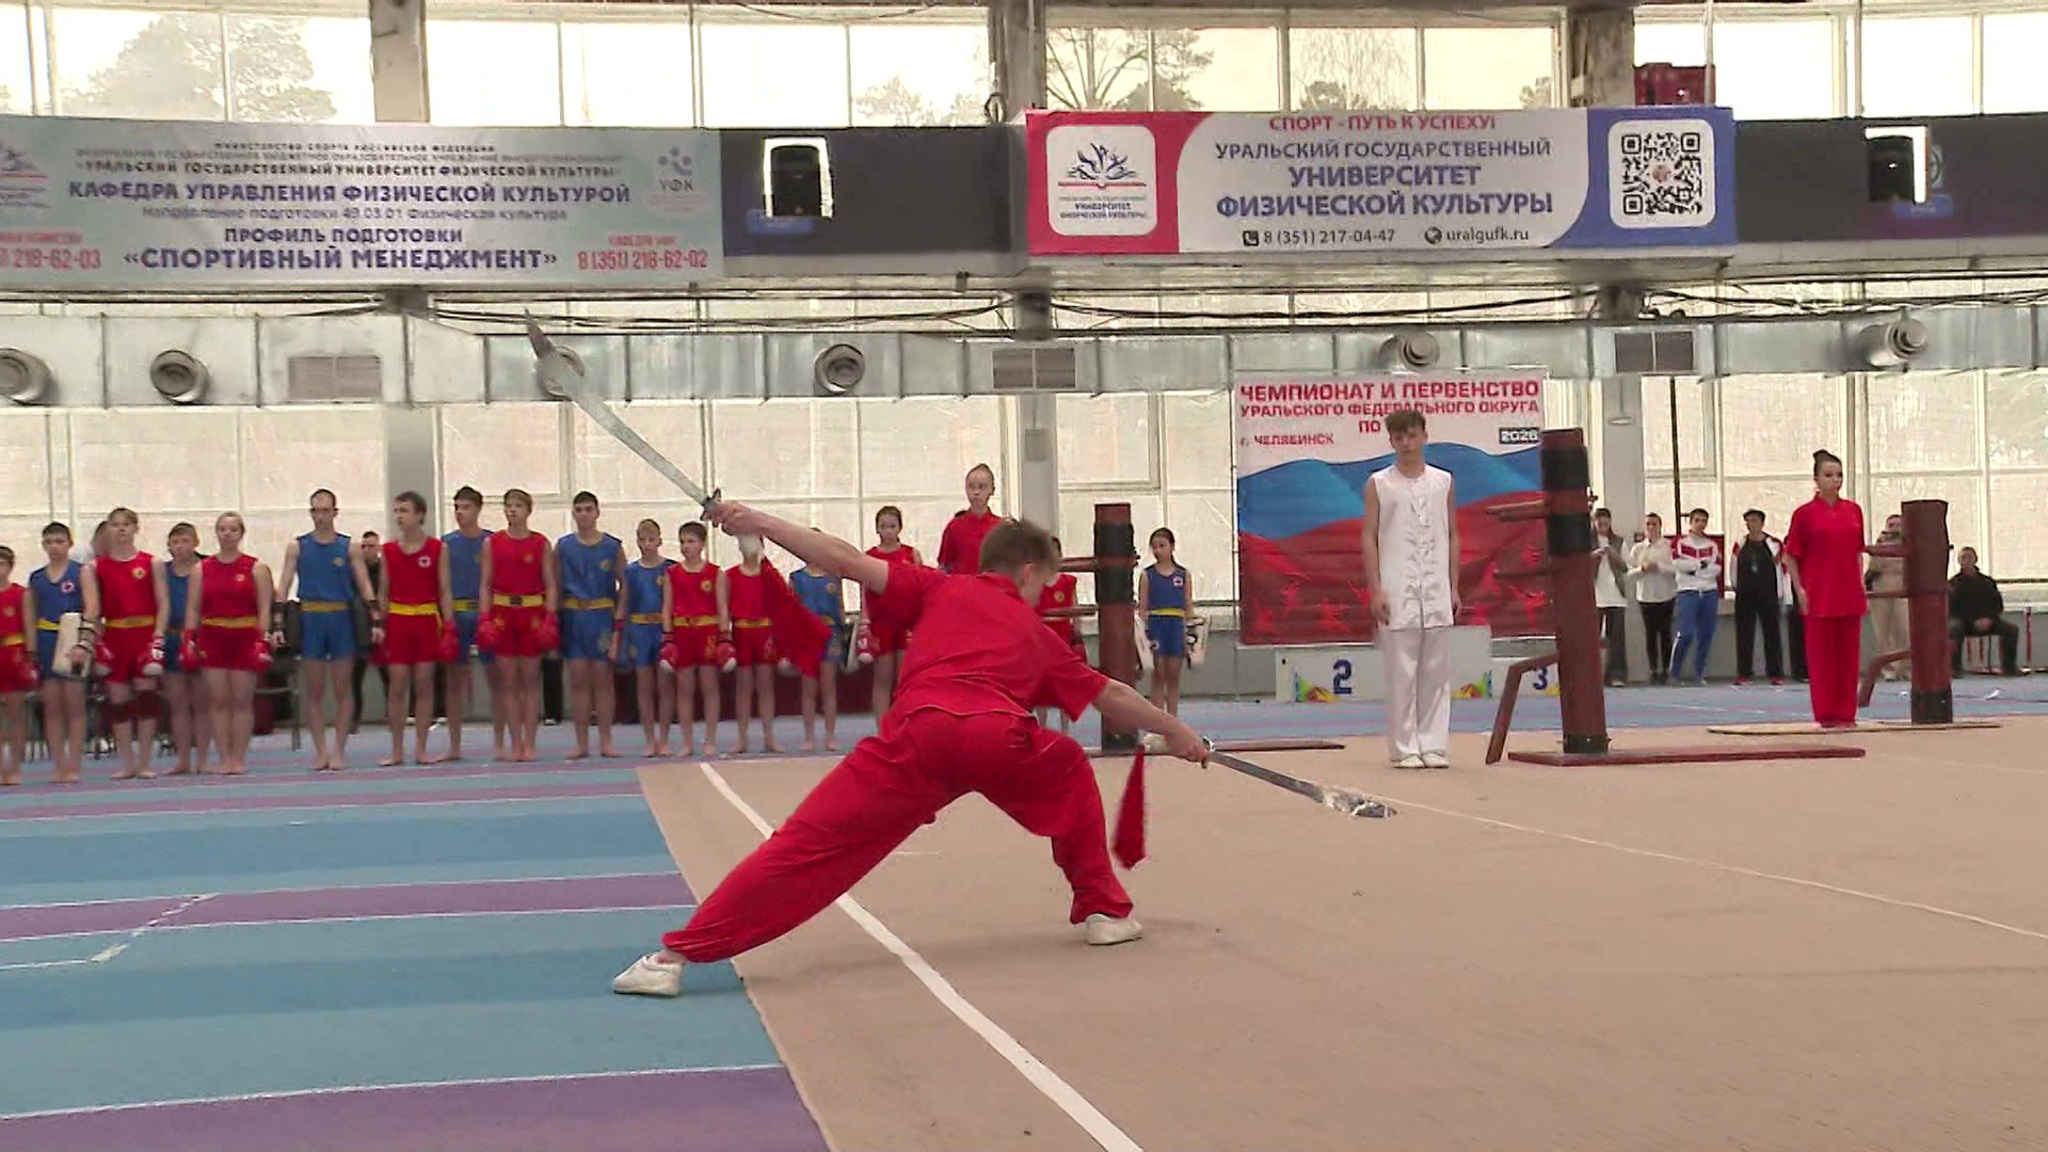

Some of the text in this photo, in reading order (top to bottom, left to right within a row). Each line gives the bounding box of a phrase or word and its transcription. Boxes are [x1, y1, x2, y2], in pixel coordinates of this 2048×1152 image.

[1269, 115, 1332, 131] СПОРТ
[1349, 115, 1397, 130] ПУТЬ
[1401, 115, 1413, 130] К
[1418, 114, 1496, 130] УСПЕХУ!
[1215, 137, 1551, 161] УРАЛЬСКИЙ ГОСУДАРСТВЕННЫЙ
[184, 162, 332, 175] ГОСУДАРСТВЕННЫЙ
[335, 164, 436, 176] УНИВЕРСИТЕТ
[439, 164, 536, 177] ФИЗИЧЕСКОЙ
[1289, 165, 1482, 188] УНИВЕРСИТЕТ
[69, 181, 178, 200] КАФЕДРА
[186, 183, 336, 201] УПРАВЛЕНИЯ
[342, 184, 496, 202] ФИЗИЧЕСКОЙ
[503, 184, 630, 202] КУЛЬТУРОЙ
[1217, 190, 1554, 218] ФИЗИЧЕСКОЙ КУЛЬТУРЫ
[249, 208, 338, 219] подготовки
[407, 209, 496, 220] Физическая
[500, 210, 567, 221] культура
[225, 228, 462, 245] ПРОФИЛЬ ПОДГОТОВКИ
[1264, 229, 1395, 246] 8 (351) 217-04-47
[1447, 227, 1529, 243] uralgufk.ru
[124, 246, 557, 270] «СПОРТИВНЫЙ МЕНЕДЖМЕНТ»
[578, 252, 588, 270] 8
[1240, 380, 1539, 401] ЧЕМПИОНАТ И ПЕРВЕНСТВО
[1240, 400, 1539, 417] УРАЛЬСКОГО ФЕДЕРАЛЬНОГО ОКРУГА
[1359, 420, 1381, 433] ПО
[1254, 434, 1334, 446] ЧЕЛЯБИНСК
[1333, 659, 1352, 694] 2
[1533, 667, 1547, 690] 3
